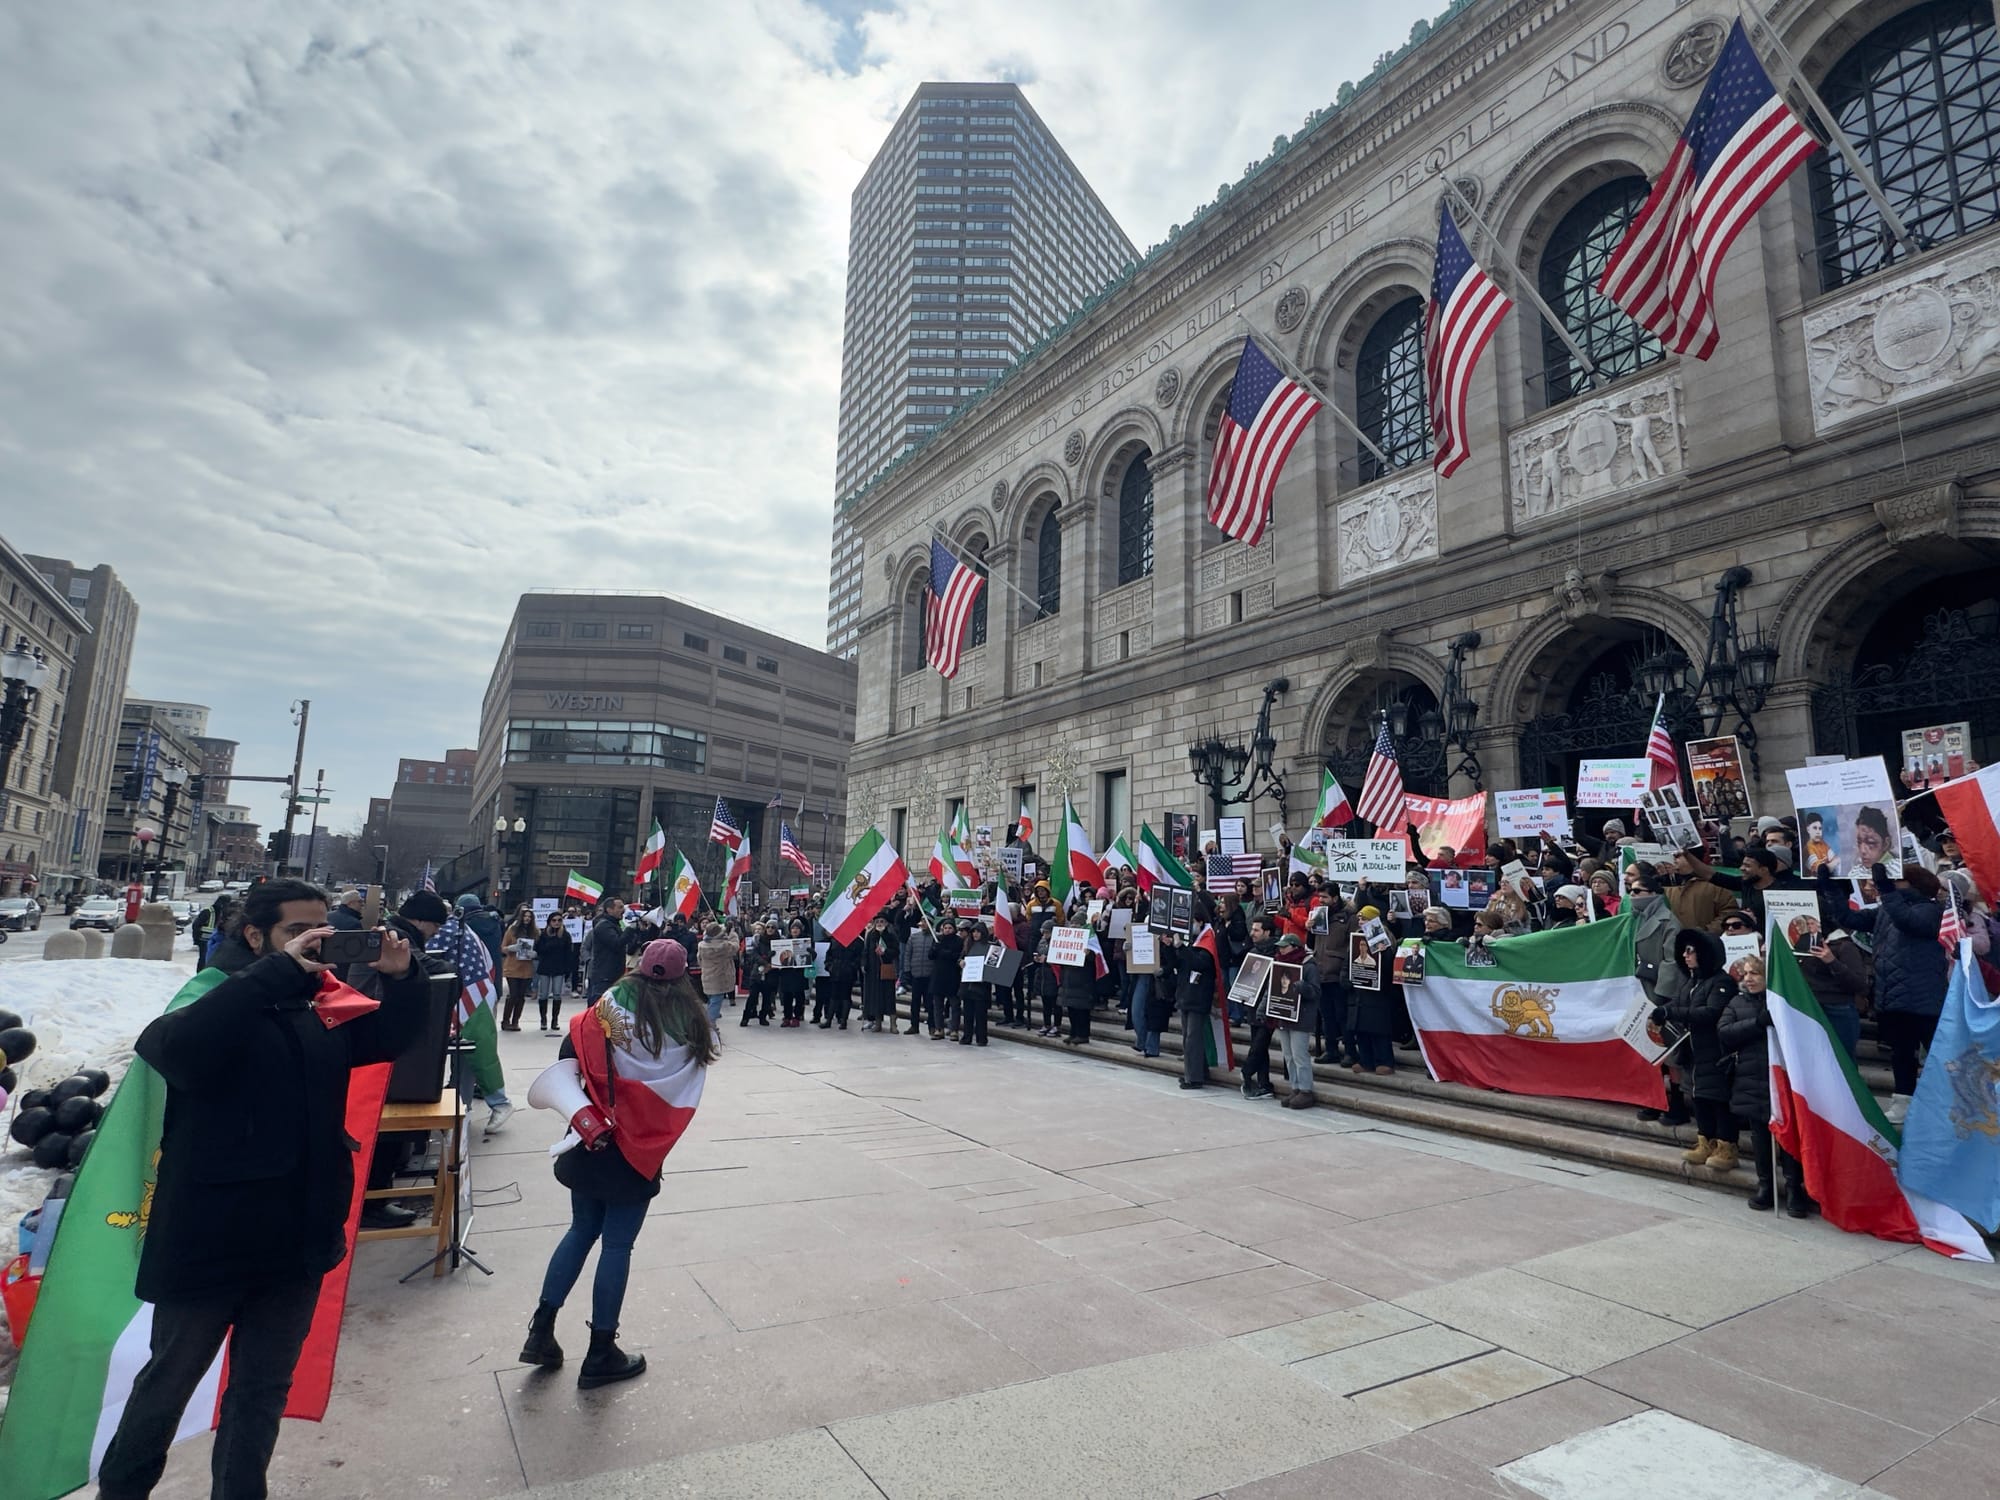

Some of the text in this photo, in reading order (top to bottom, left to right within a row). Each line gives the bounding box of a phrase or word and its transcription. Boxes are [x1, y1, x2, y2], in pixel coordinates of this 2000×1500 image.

[925, 477, 969, 520] LIBRARY
[973, 462, 990, 483] OF
[1000, 442, 1021, 466] THE
[1028, 411, 1062, 446] CITY
[1071, 391, 1092, 417] OF
[1101, 334, 1174, 399] BOSTON
[1186, 284, 1245, 340] BUILT
[1259, 250, 1290, 290] BY
[1310, 199, 1369, 251] THE
[1388, 100, 1512, 202] PEOPLE
[1542, 21, 1631, 99] AND
[544, 692, 624, 711] WESTIN
[1513, 822, 1554, 830] REVOLUTION
[1338, 841, 1356, 849] FREE
[1370, 842, 1399, 851] PEACE
[1335, 863, 1358, 873] IRAN
[1057, 929, 1072, 938] STOP
